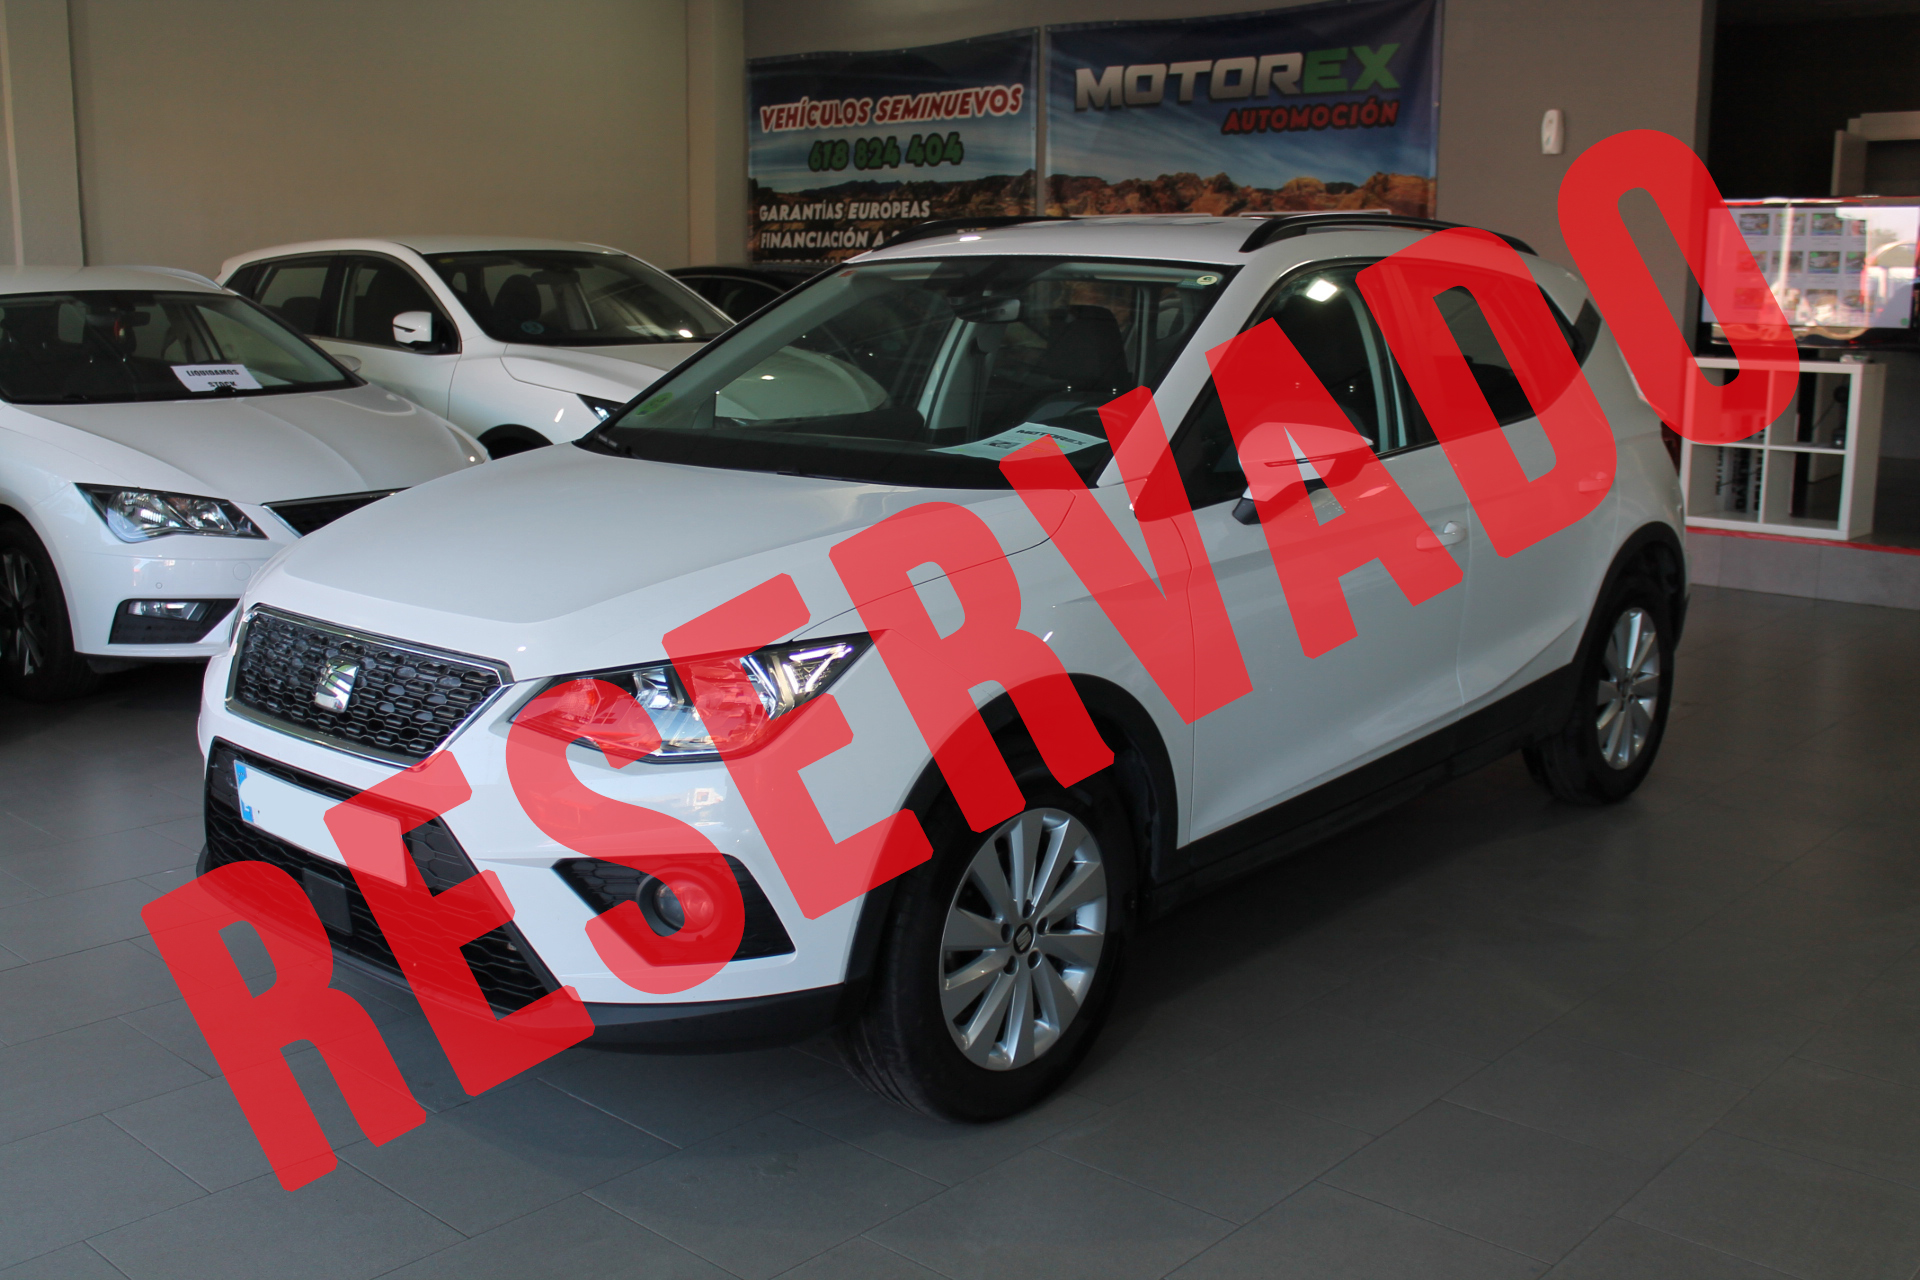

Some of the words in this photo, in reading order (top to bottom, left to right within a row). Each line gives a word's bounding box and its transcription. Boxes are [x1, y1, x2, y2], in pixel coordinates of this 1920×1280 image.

[1074, 44, 1400, 110] MOTOREX
[760, 97, 872, 132] VEHÍCULOS
[874, 84, 1023, 124] SEMINUEVOS
[1222, 98, 1398, 134] AUTOMOCIÓN
[808, 139, 849, 171] 618
[853, 136, 900, 170] 824
[905, 132, 964, 167] 404
[759, 200, 844, 221] GARANTÍAS
[848, 201, 931, 219] EUROPEAS
[760, 227, 868, 248] FINANCIACIÓN
[872, 231, 884, 247] A
[186, 369, 239, 377] LIQUIDAMOS
